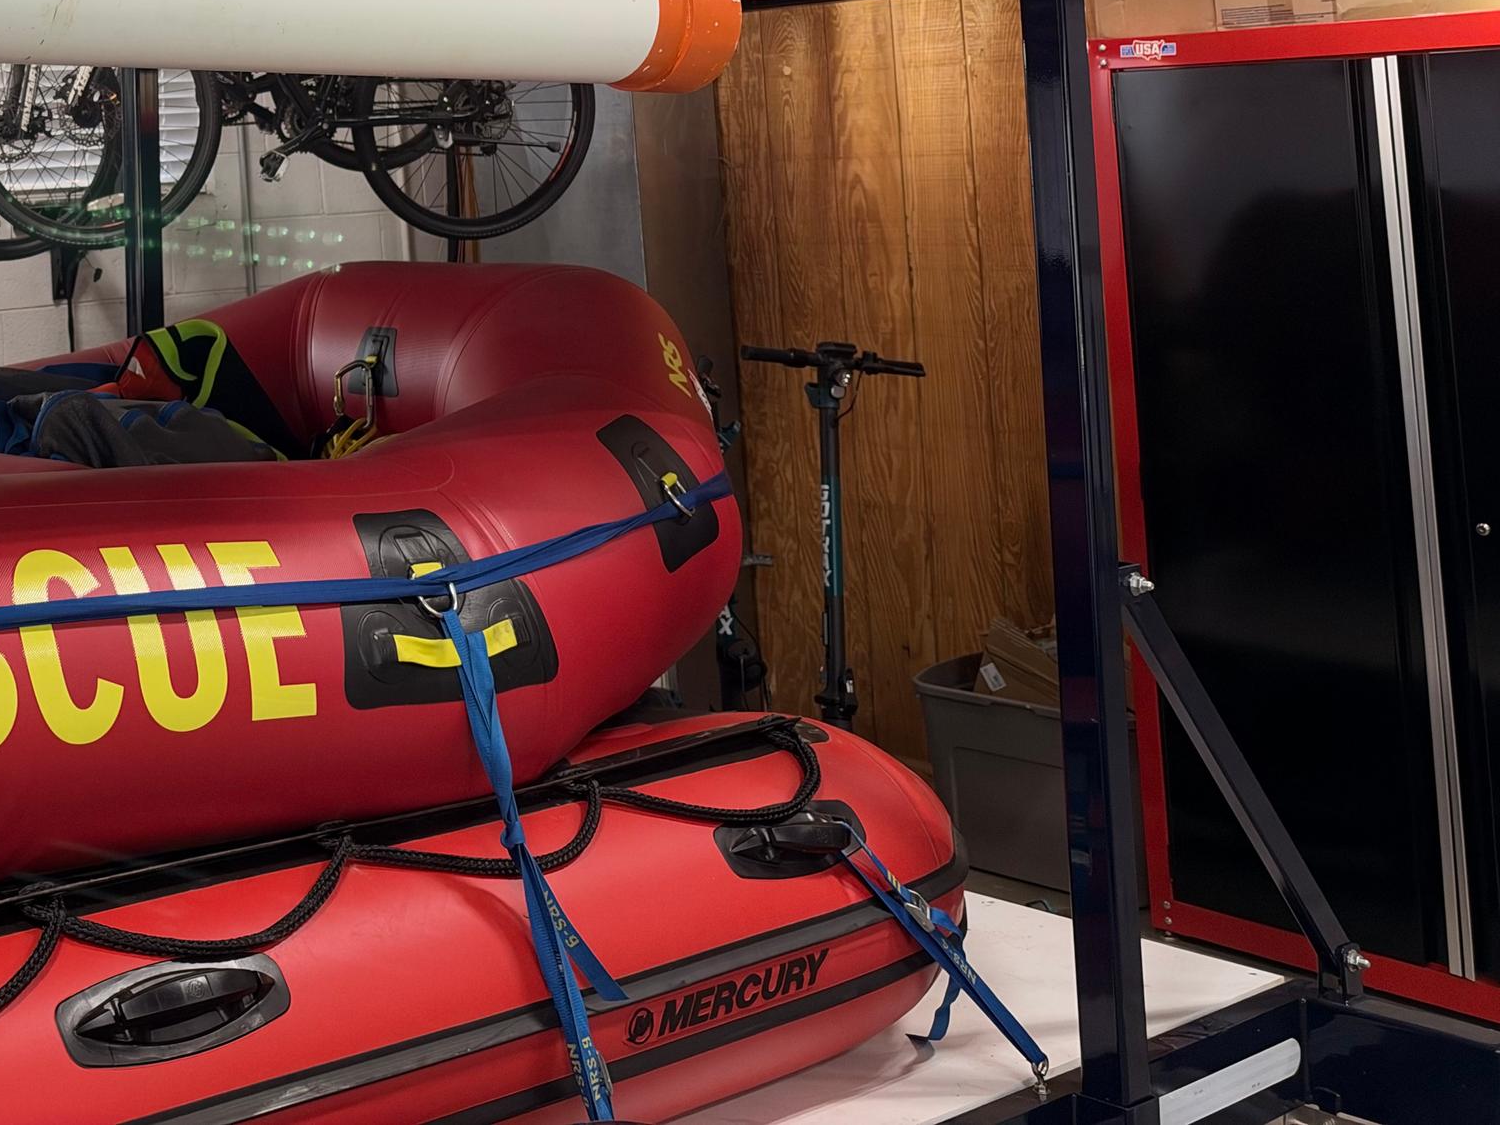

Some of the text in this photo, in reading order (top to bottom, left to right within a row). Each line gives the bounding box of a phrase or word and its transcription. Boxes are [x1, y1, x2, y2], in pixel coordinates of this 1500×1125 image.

[1135, 43, 1160, 56] USA
[658, 332, 693, 399] NRS
[657, 948, 830, 1037] MERCURY
[580, 1036, 602, 1101] NRS-9
